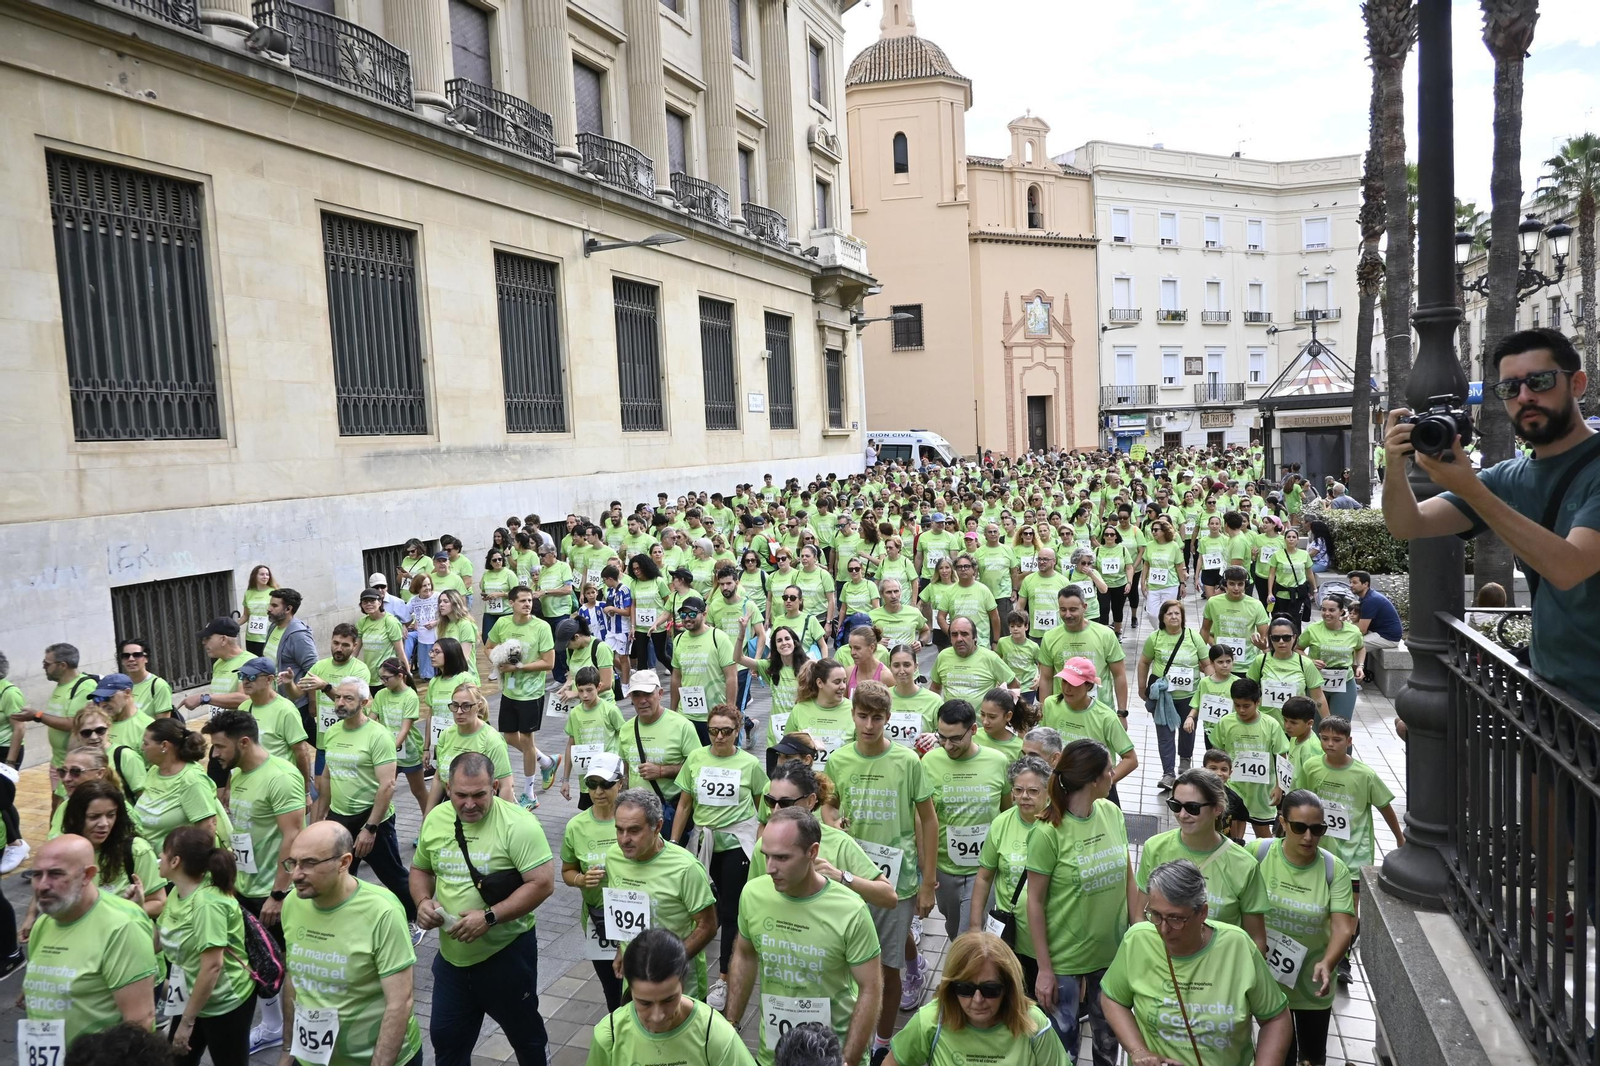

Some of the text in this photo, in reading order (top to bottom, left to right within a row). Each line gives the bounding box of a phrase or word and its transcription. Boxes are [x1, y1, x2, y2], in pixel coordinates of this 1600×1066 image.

[454, 851, 491, 861] mrcha
[1080, 861, 1113, 879] contra
[1268, 906, 1309, 922] ontra
[292, 943, 347, 964] En marcha
[762, 934, 826, 958] En marcha
[289, 960, 346, 980] contra el
[762, 952, 823, 972] contra el
